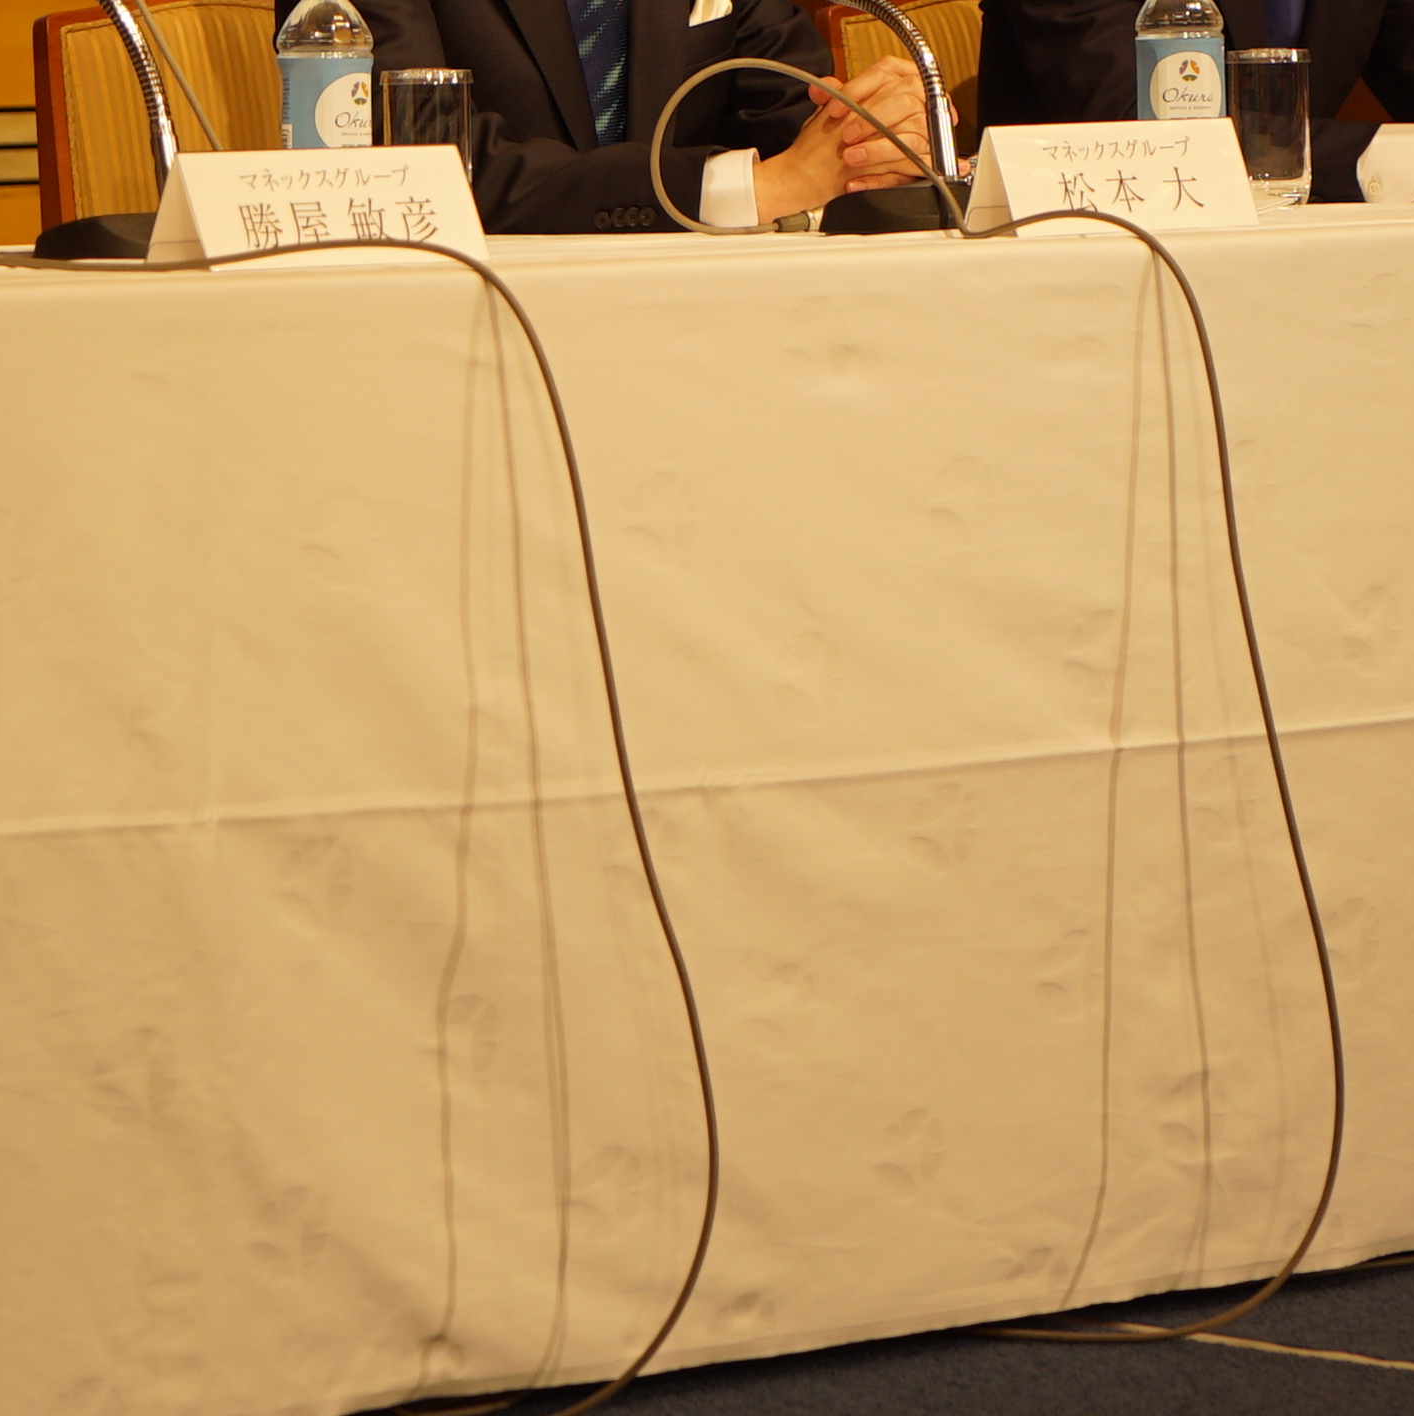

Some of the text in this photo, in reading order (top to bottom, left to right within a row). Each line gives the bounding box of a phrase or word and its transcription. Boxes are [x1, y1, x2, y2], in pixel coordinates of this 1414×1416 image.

[1042, 135, 1191, 163] マネックスグループ
[239, 164, 410, 192] マネックスグループ
